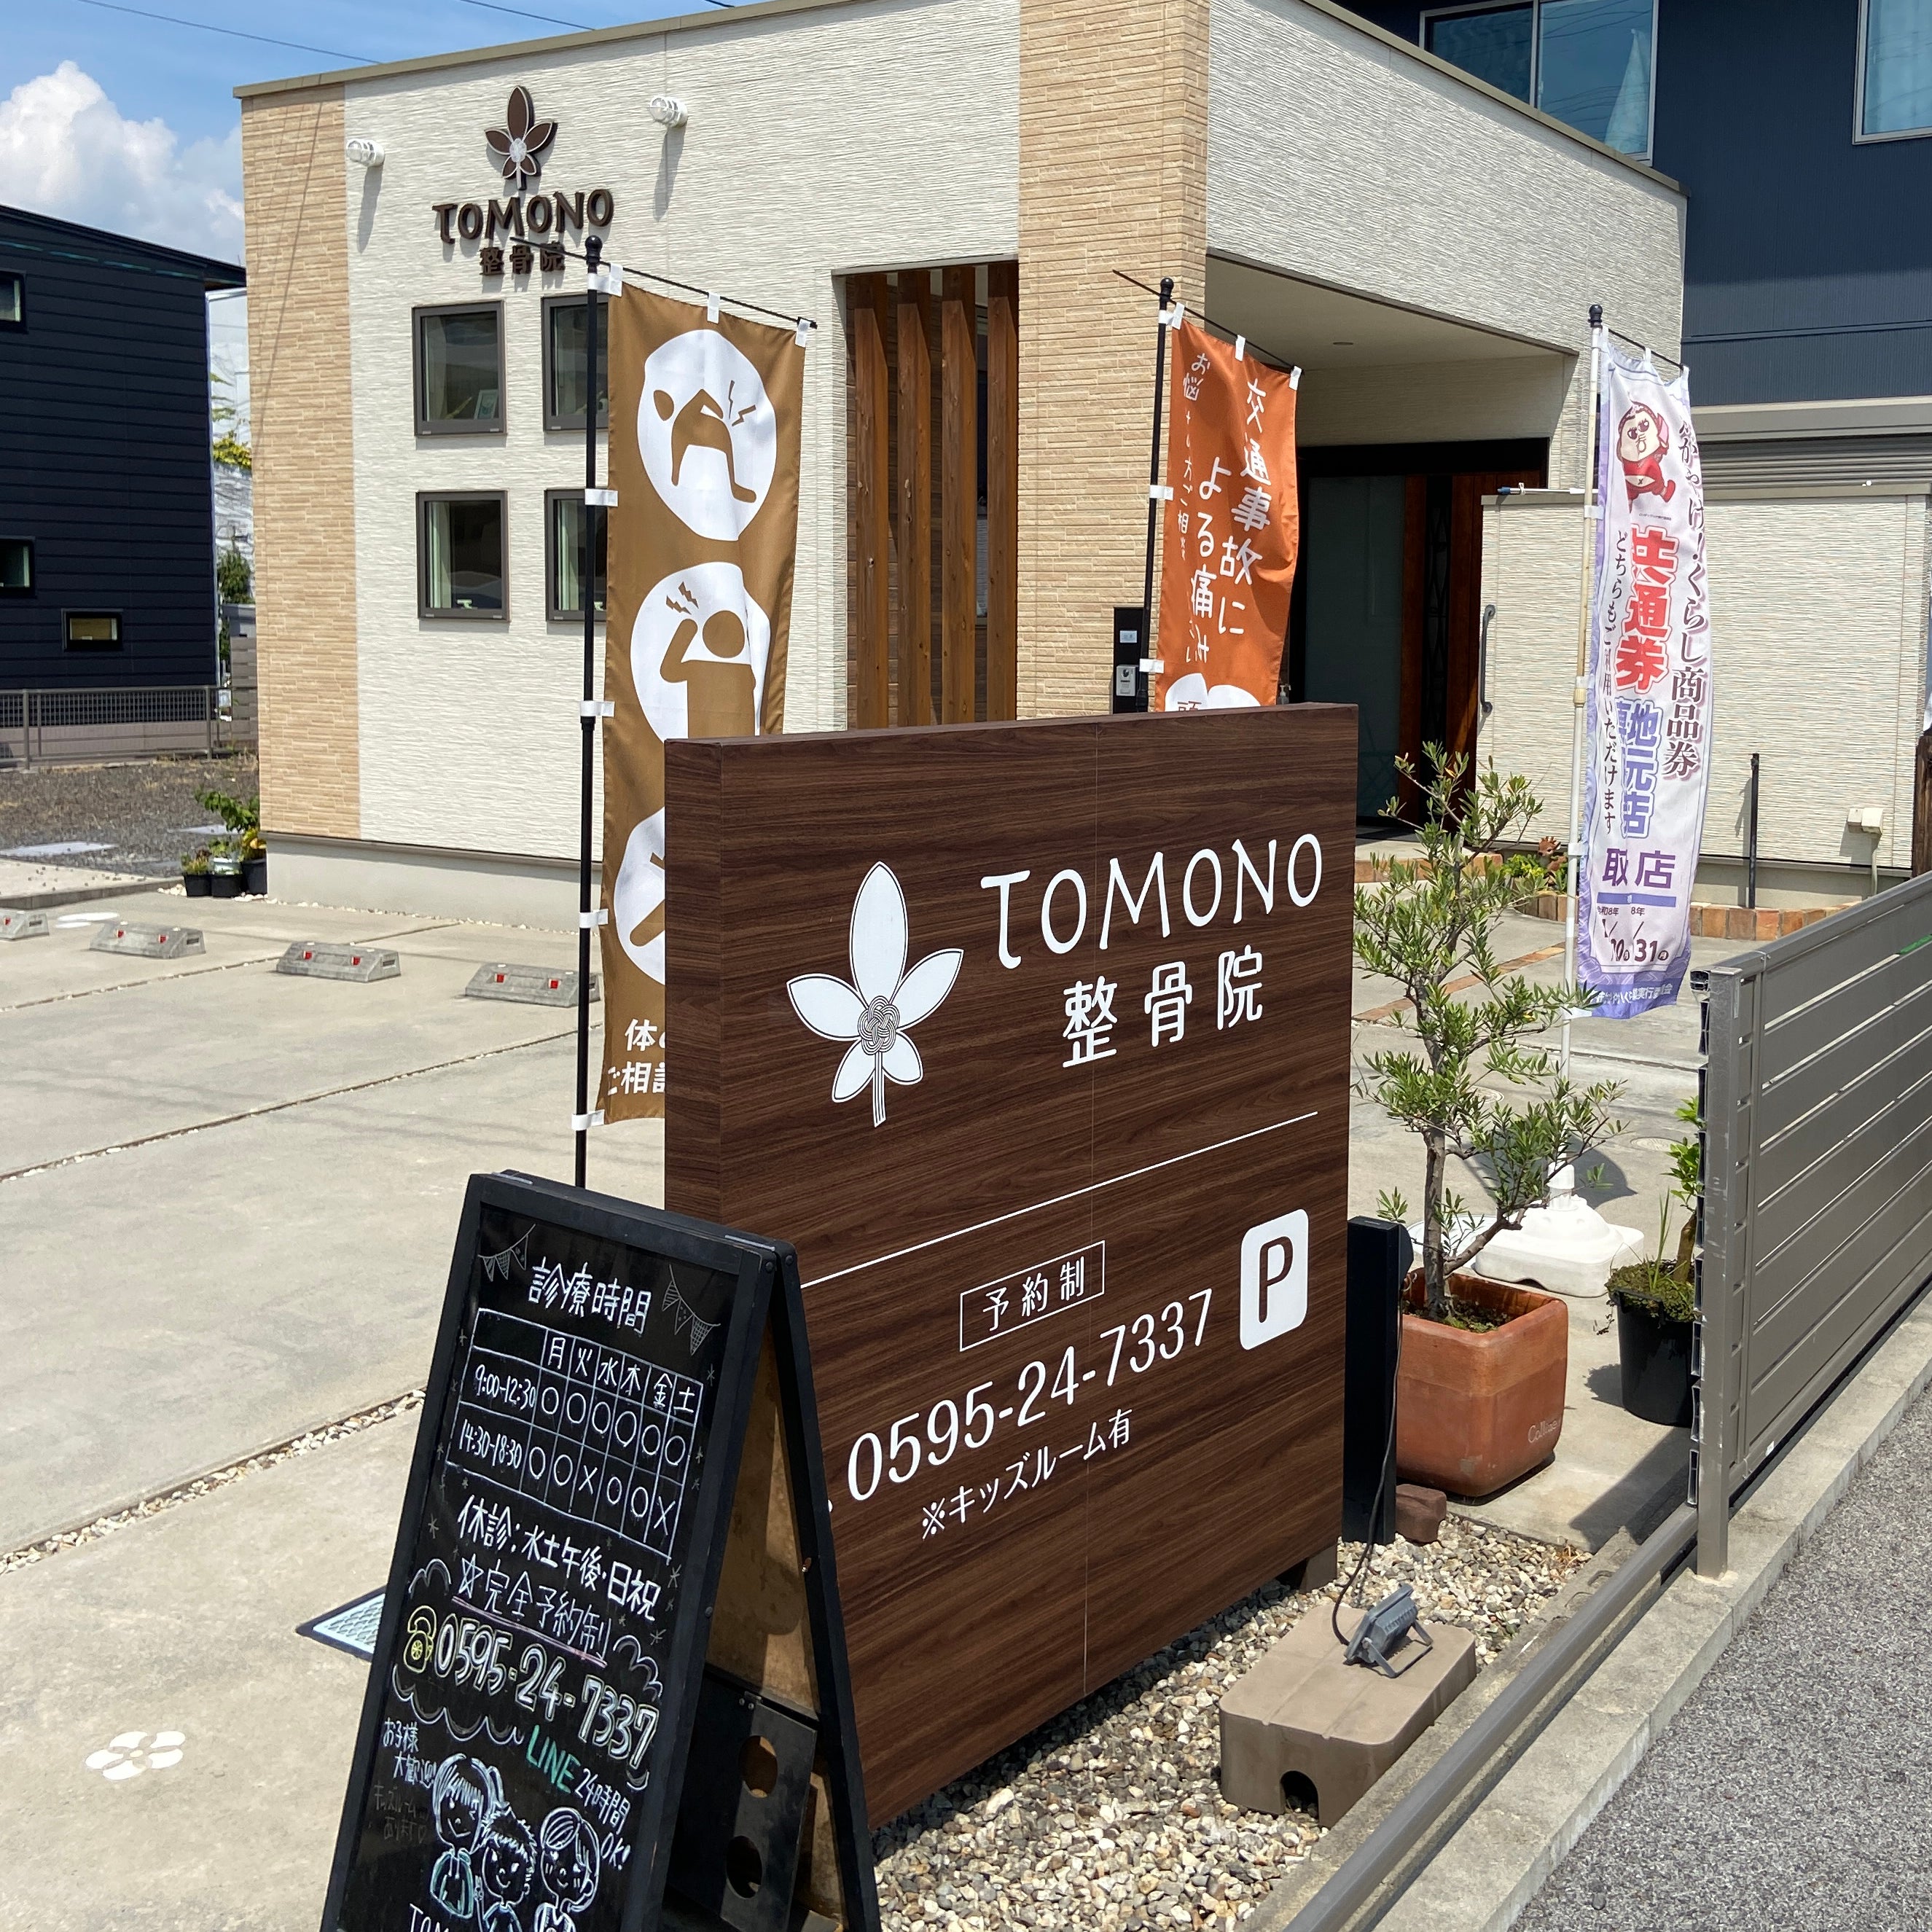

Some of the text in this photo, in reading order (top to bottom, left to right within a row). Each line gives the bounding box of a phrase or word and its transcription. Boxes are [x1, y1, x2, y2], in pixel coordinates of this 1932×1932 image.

[432, 189, 614, 243] TOMONO
[480, 242, 566, 275] 整骨院
[1218, 378, 1272, 635] 交通事故に
[980, 833, 1323, 969] TOMONO
[1062, 945, 1264, 1068] 整骨院
[528, 1256, 652, 1335] 診療時間
[982, 1256, 1085, 1333] 予約制
[1258, 1235, 1294, 1323] P
[475, 1365, 536, 1409] 9:00-12:30
[847, 1288, 1213, 1502] 0595-24-7337
[459, 1419, 523, 1469] 14:30-18:30
[525, 1725, 581, 1794] LINE
[601, 1832, 631, 1871] OK!
